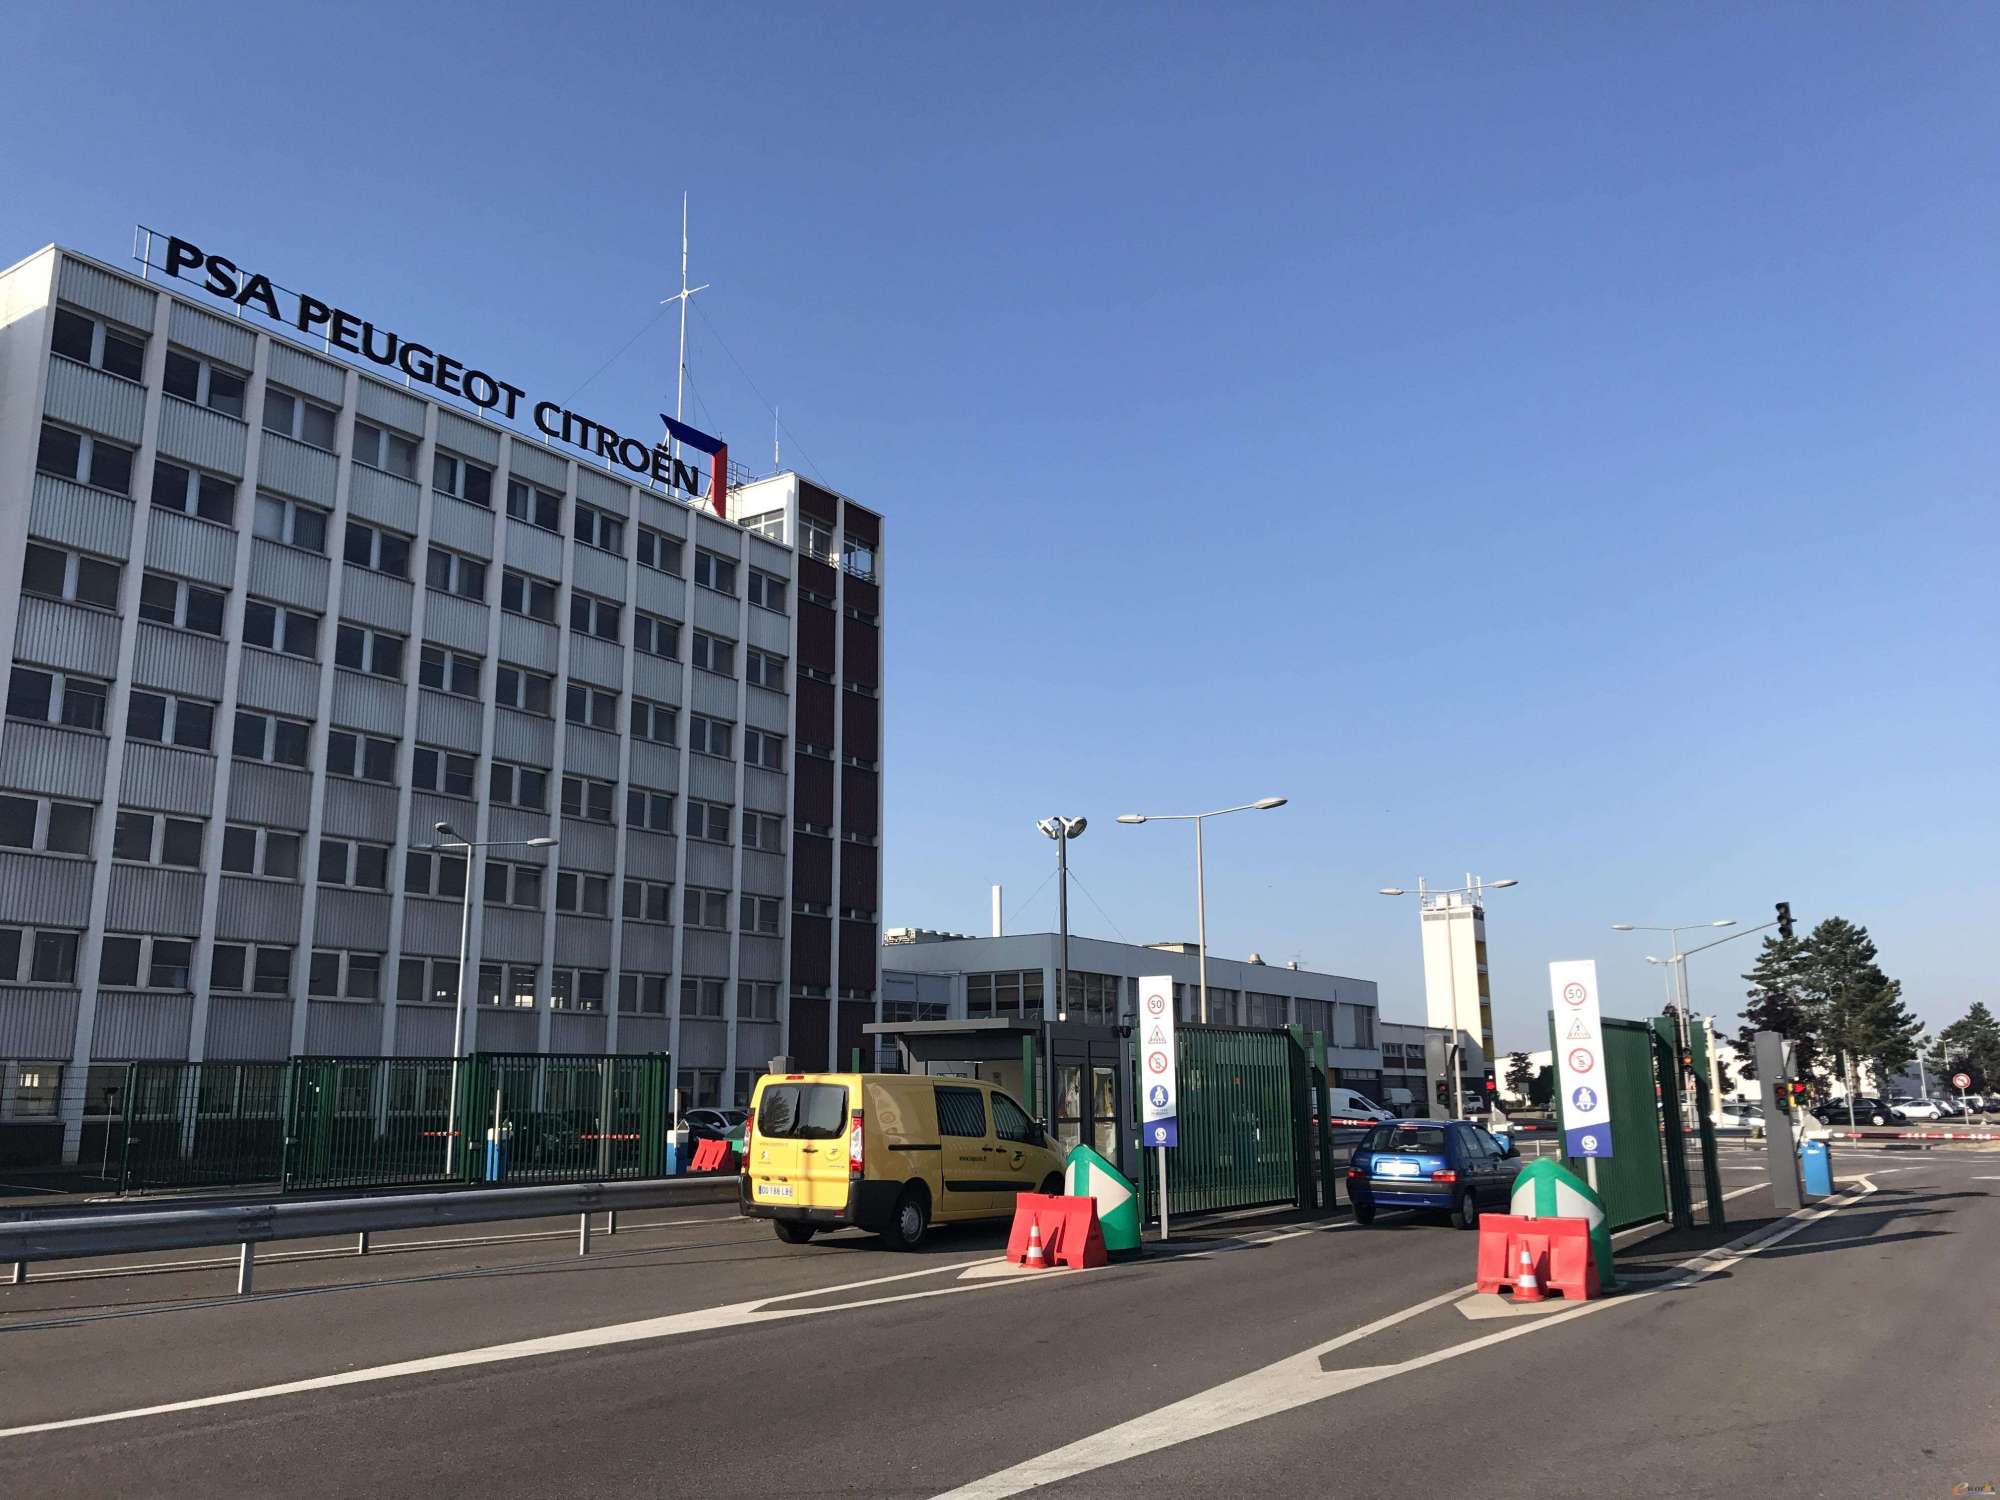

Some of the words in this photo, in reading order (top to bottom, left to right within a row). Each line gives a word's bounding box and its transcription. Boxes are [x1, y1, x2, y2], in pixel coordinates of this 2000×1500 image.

[166, 236, 281, 321] PSA
[297, 293, 526, 419] PEUGEOT
[533, 401, 699, 496] CITROËN
[1568, 988, 1583, 999] 50
[1150, 1000, 1162, 1009] 50
